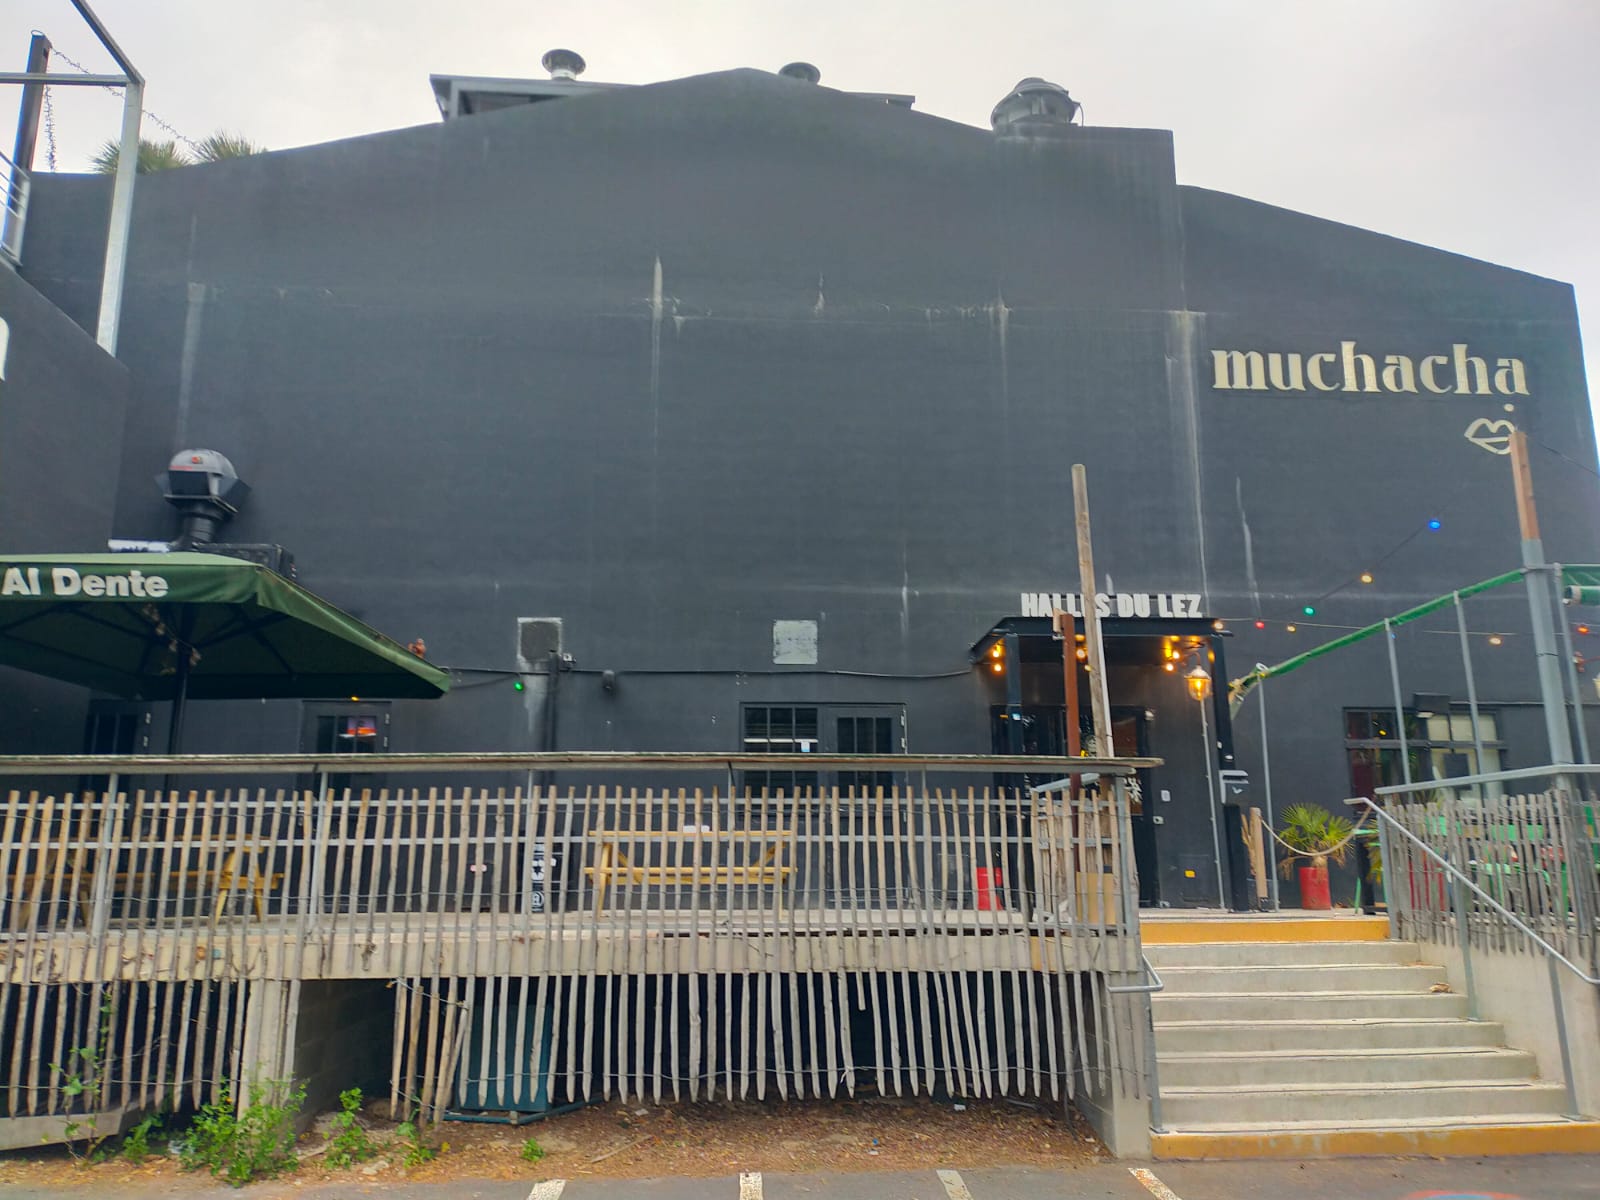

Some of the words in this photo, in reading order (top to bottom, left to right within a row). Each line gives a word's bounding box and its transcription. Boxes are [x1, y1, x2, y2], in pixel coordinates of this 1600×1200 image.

[1211, 341, 1530, 395] muchacha
[2, 567, 41, 595] Al
[52, 567, 169, 598] Dente
[1021, 592, 1111, 618] HALLS
[1116, 593, 1150, 618] DU
[1157, 593, 1203, 618] LEZ
